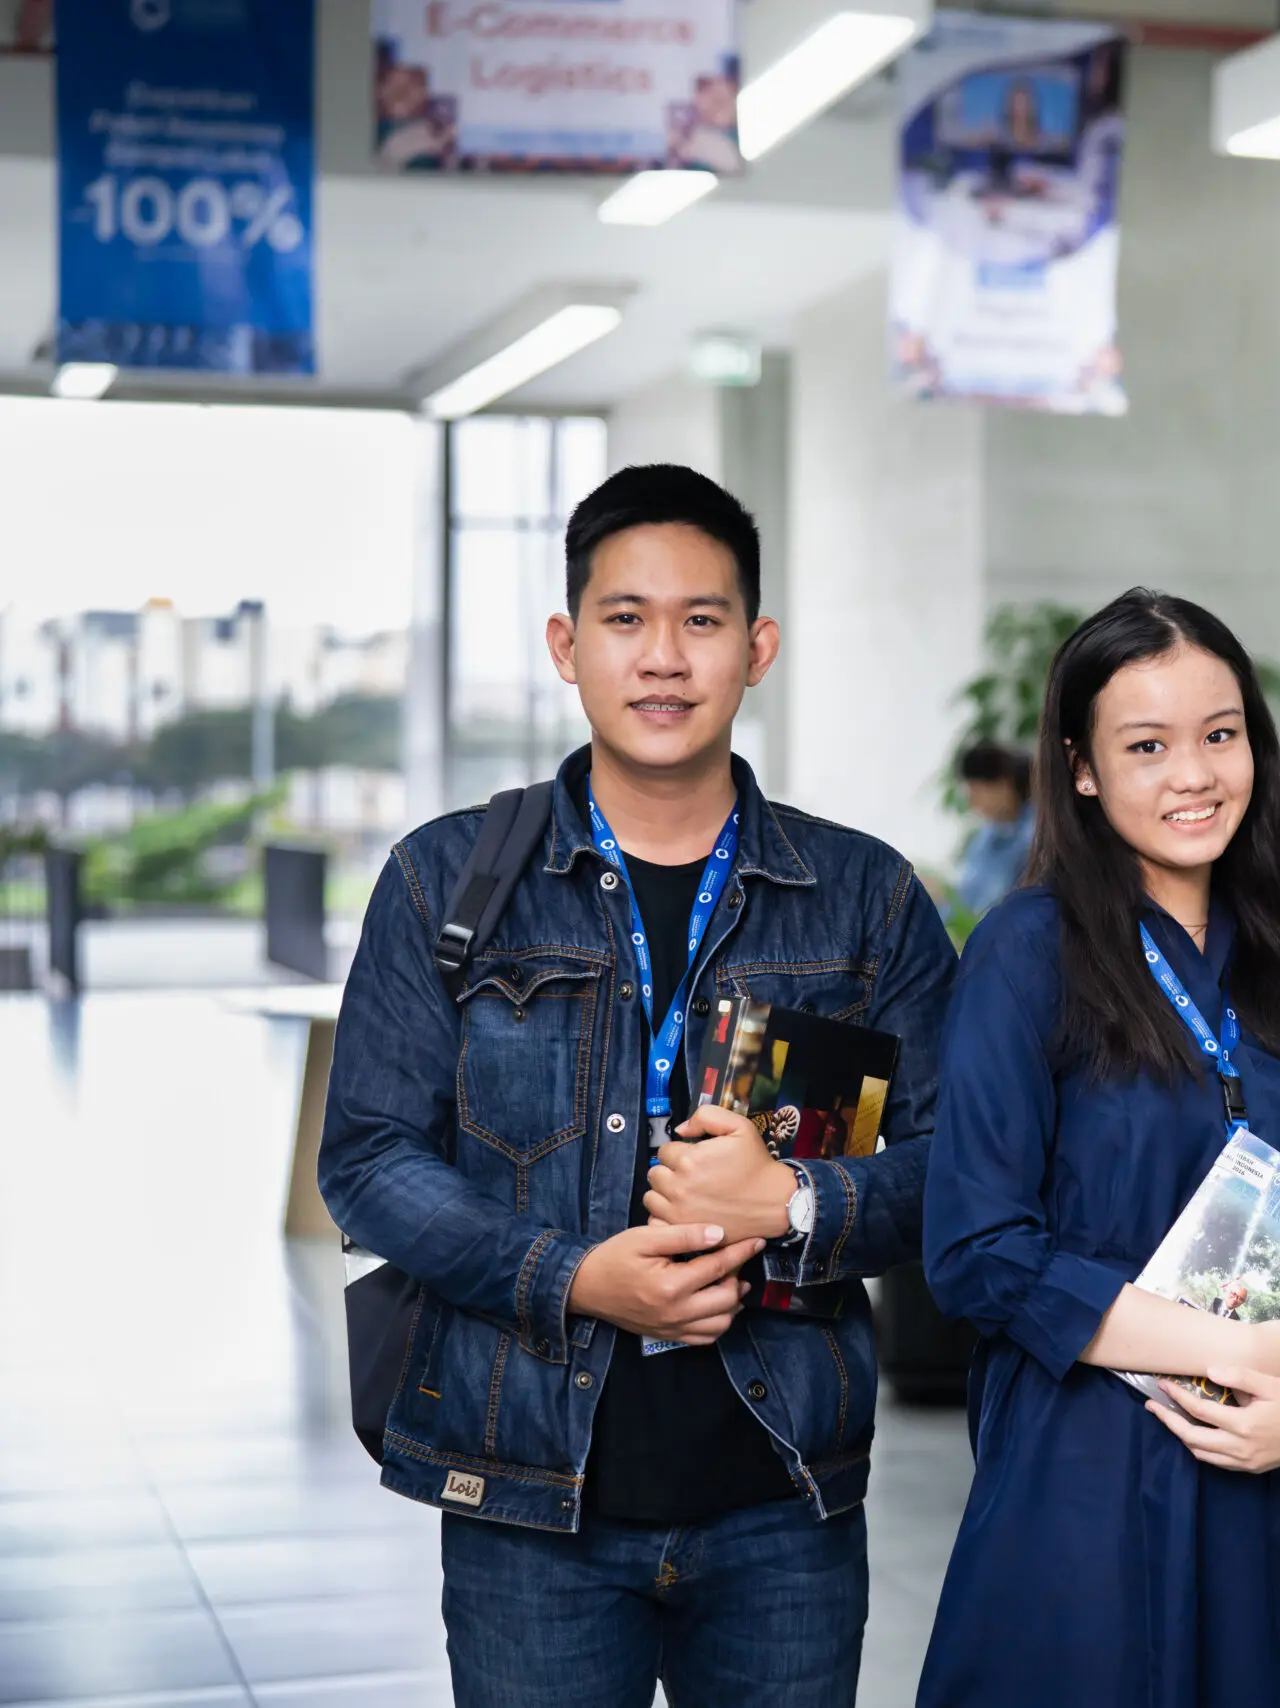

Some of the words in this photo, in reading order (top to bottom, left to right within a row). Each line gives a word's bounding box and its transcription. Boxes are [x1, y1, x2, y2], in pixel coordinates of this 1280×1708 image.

[425, 2, 695, 44] E-Commerce
[470, 57, 654, 97] Logistics
[85, 176, 304, 252] 100%
[448, 1476, 480, 1498] Lois
